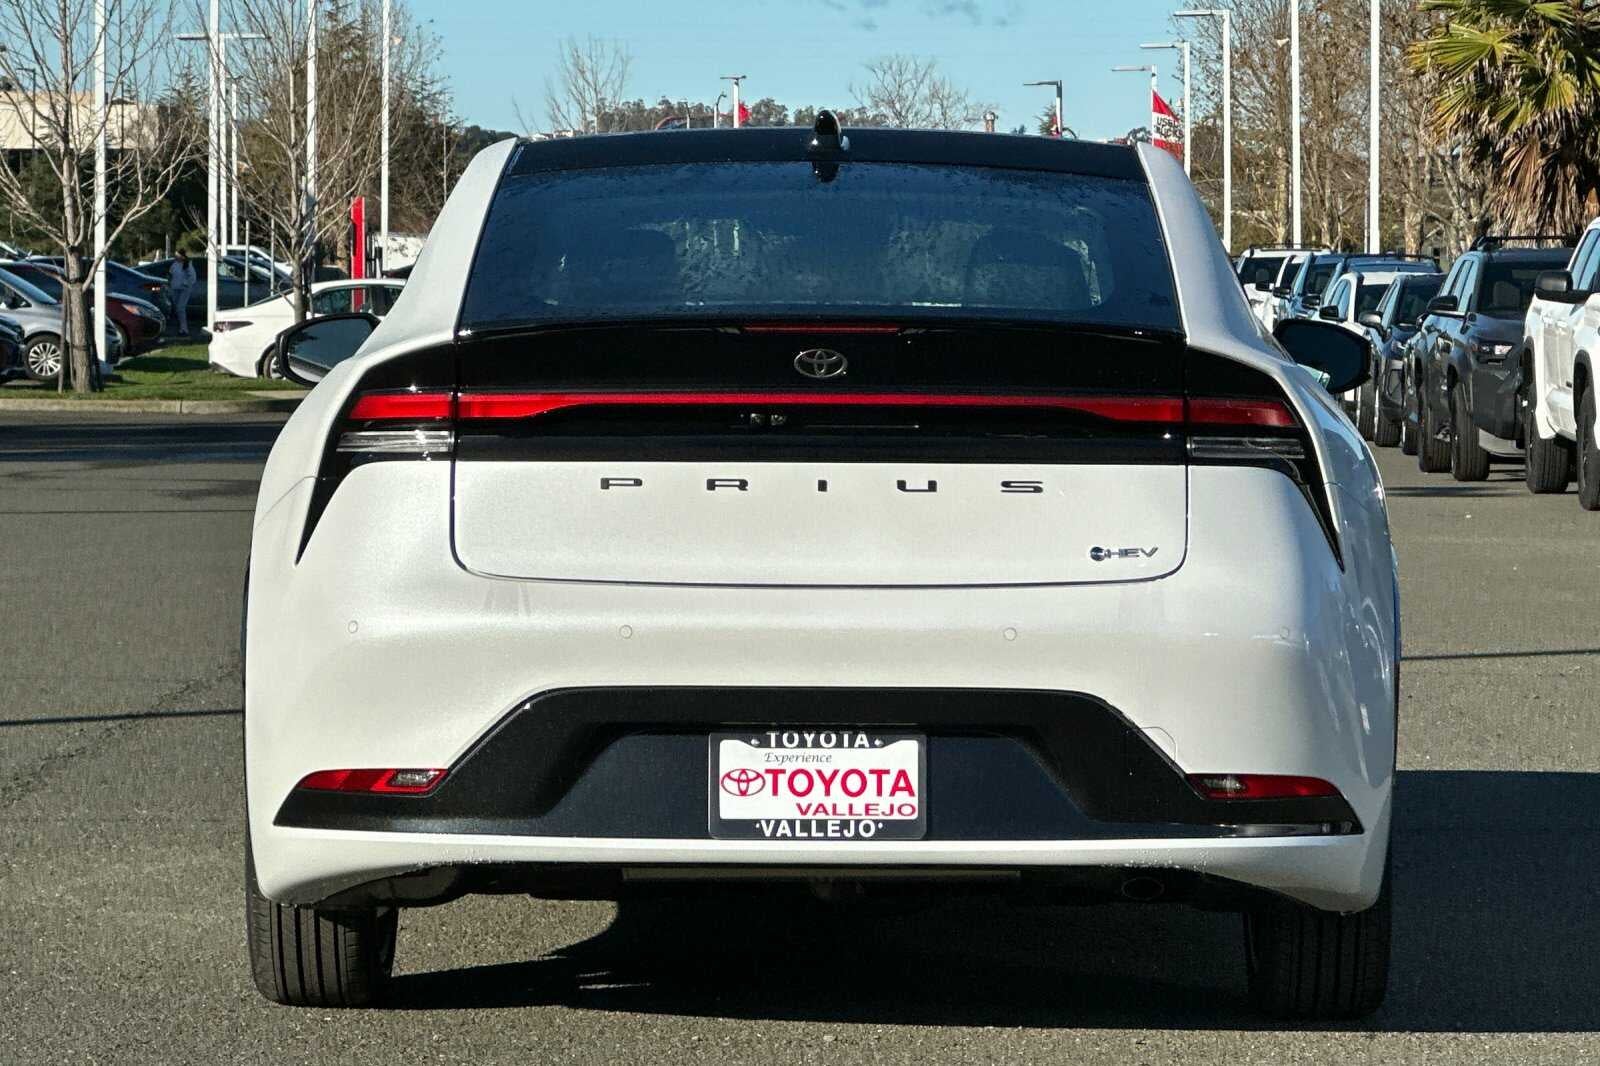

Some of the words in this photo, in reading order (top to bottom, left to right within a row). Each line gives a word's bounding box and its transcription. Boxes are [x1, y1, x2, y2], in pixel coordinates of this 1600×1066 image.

[600, 477, 1044, 494] PRIUS
[766, 731, 870, 748] TOYOTA
[764, 751, 832, 765] Experience
[764, 768, 916, 798] TOYOTA
[796, 802, 917, 817] VALLEJO
[759, 819, 876, 838] VALLEJO
